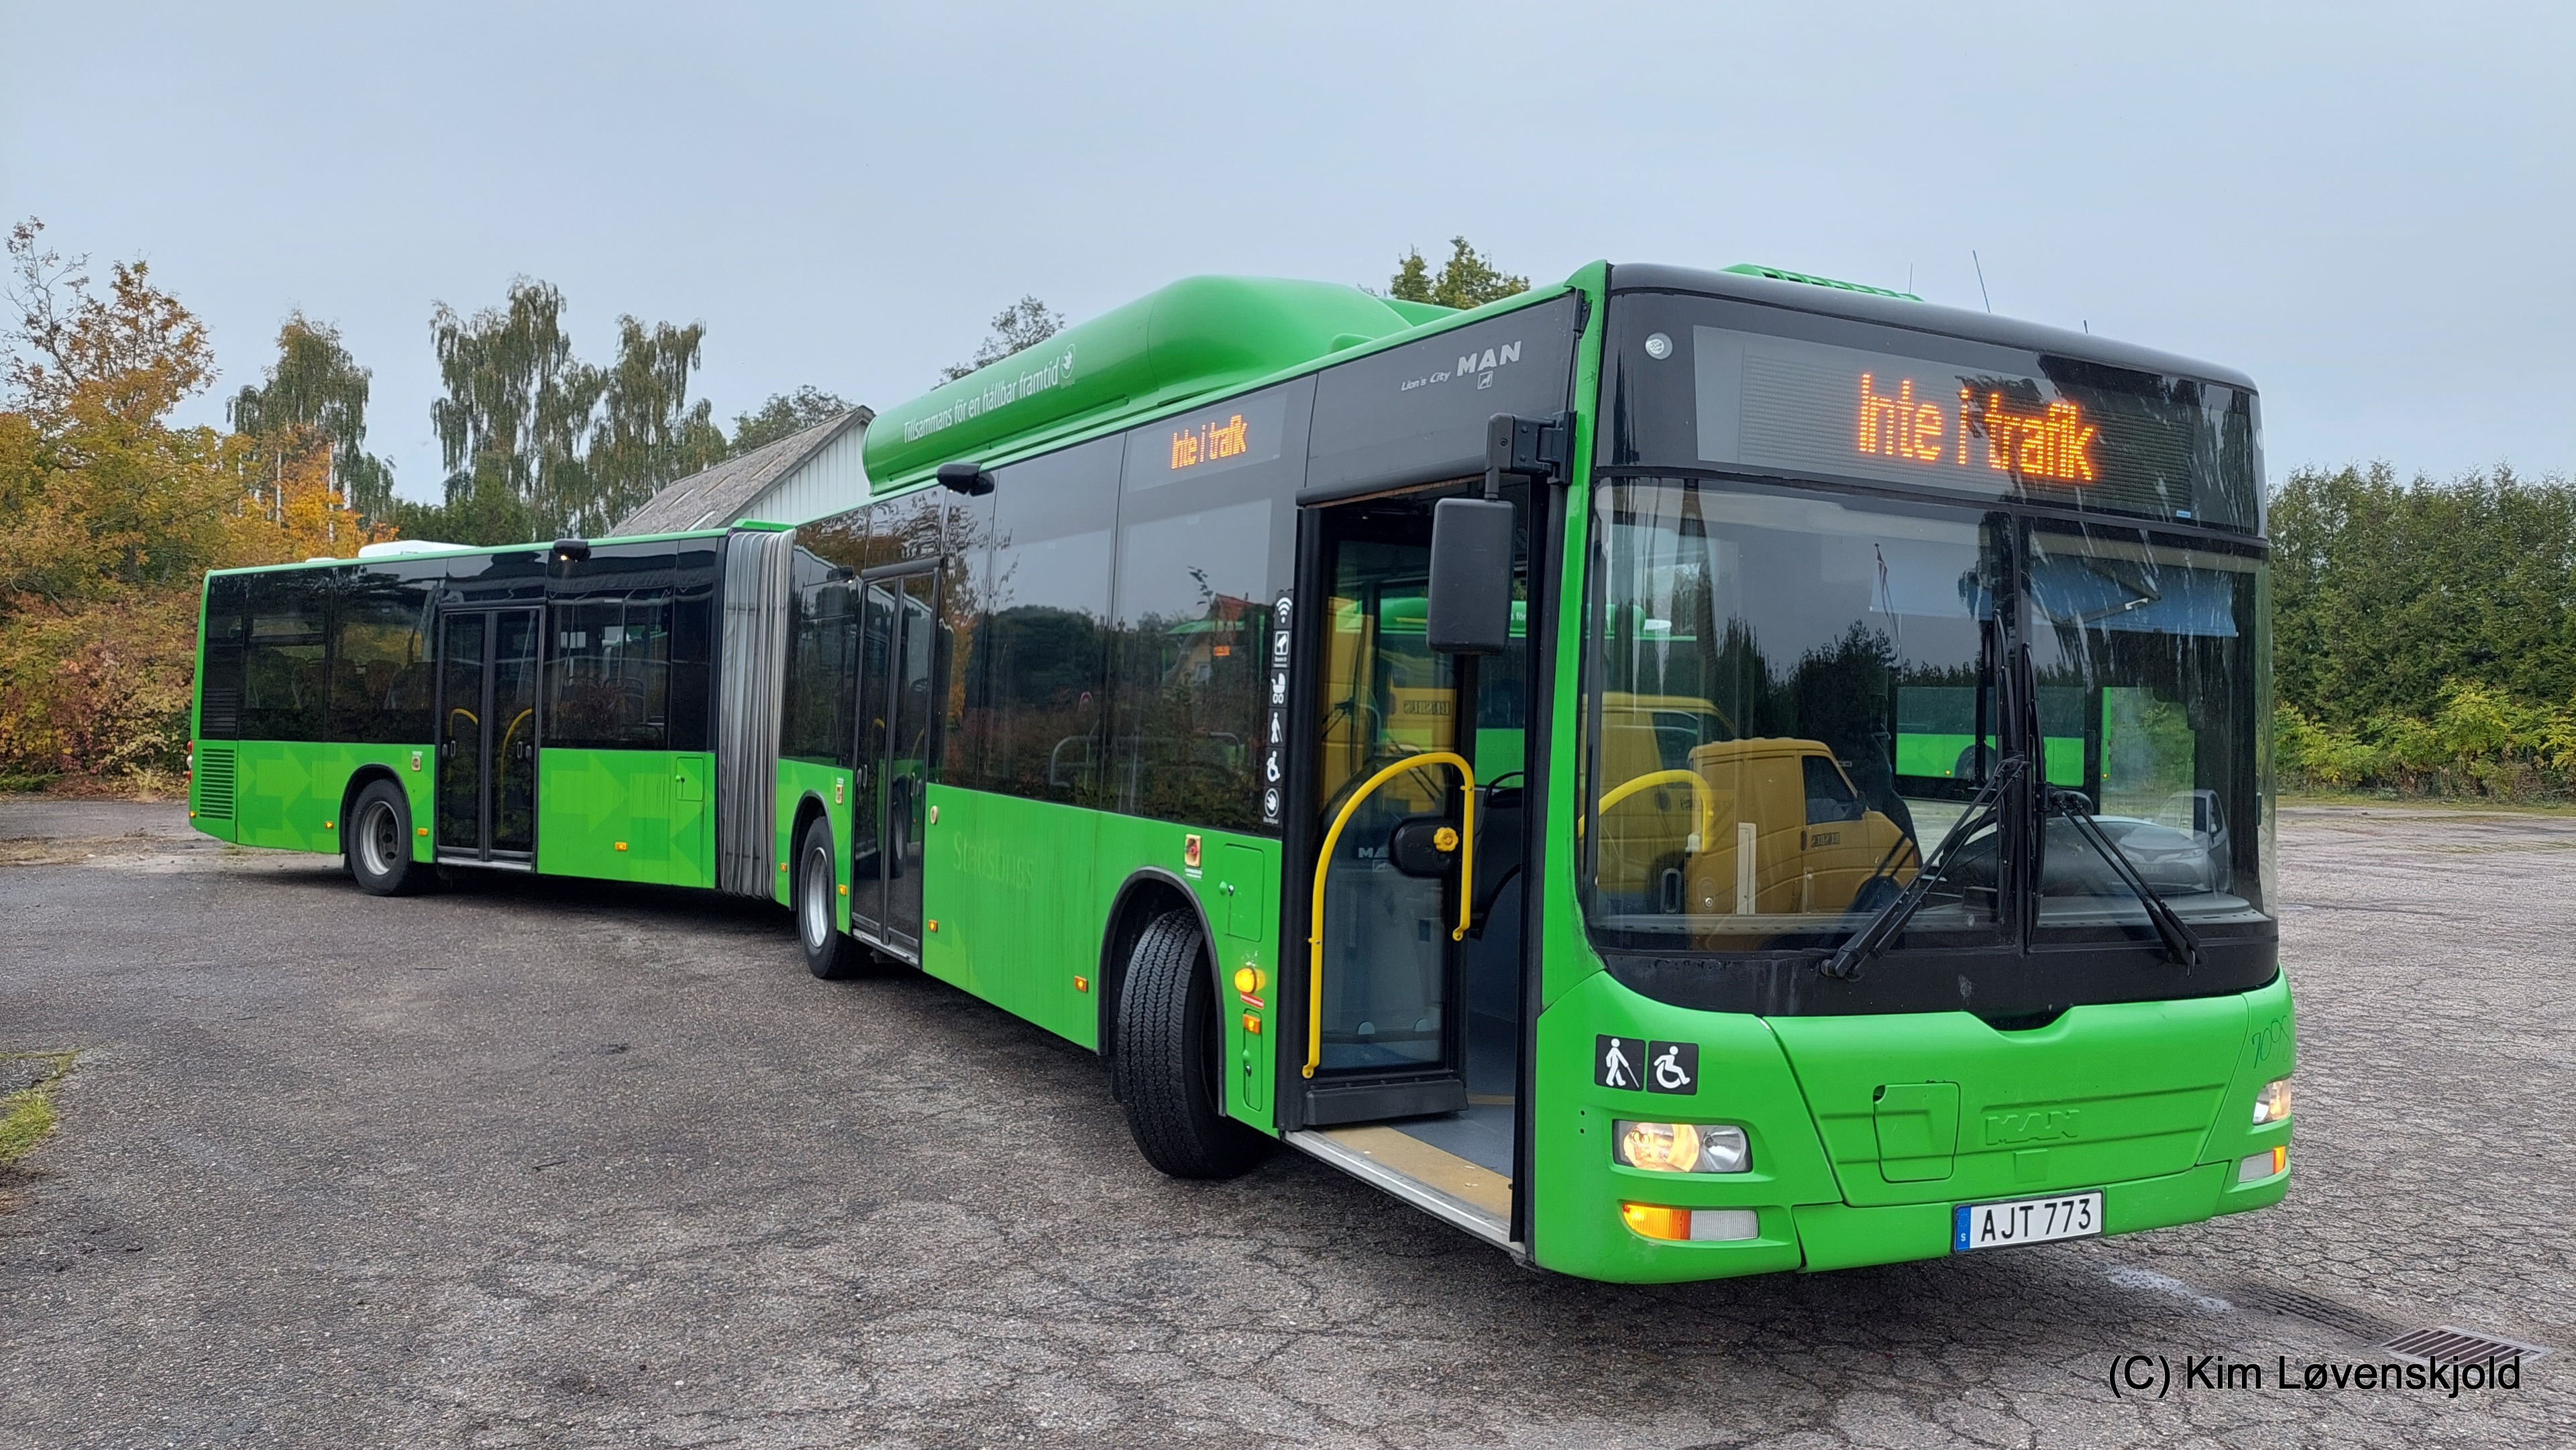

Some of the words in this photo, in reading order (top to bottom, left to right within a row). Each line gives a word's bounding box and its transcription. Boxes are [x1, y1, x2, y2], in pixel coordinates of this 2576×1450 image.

[1401, 377, 1427, 391] Lion's
[1430, 372, 1451, 383] City
[1457, 341, 1521, 377] MAN
[904, 406, 953, 444] Tillsammans
[955, 398, 967, 425] för
[969, 402, 979, 418] en
[983, 380, 1018, 413] hållbar
[1019, 356, 1060, 399] framtid
[1171, 429, 1198, 469] Inte
[1199, 424, 1207, 463] i
[1858, 373, 1943, 461] Inte
[1956, 388, 1970, 465] i
[1984, 392, 2096, 482] trafik
[1358, 846, 1389, 858] MA
[1986, 1109, 2080, 1146] MAN
[1960, 1233, 1966, 1241] S
[1980, 1205, 2034, 1241] AJT
[2045, 1198, 2091, 1235] 773
